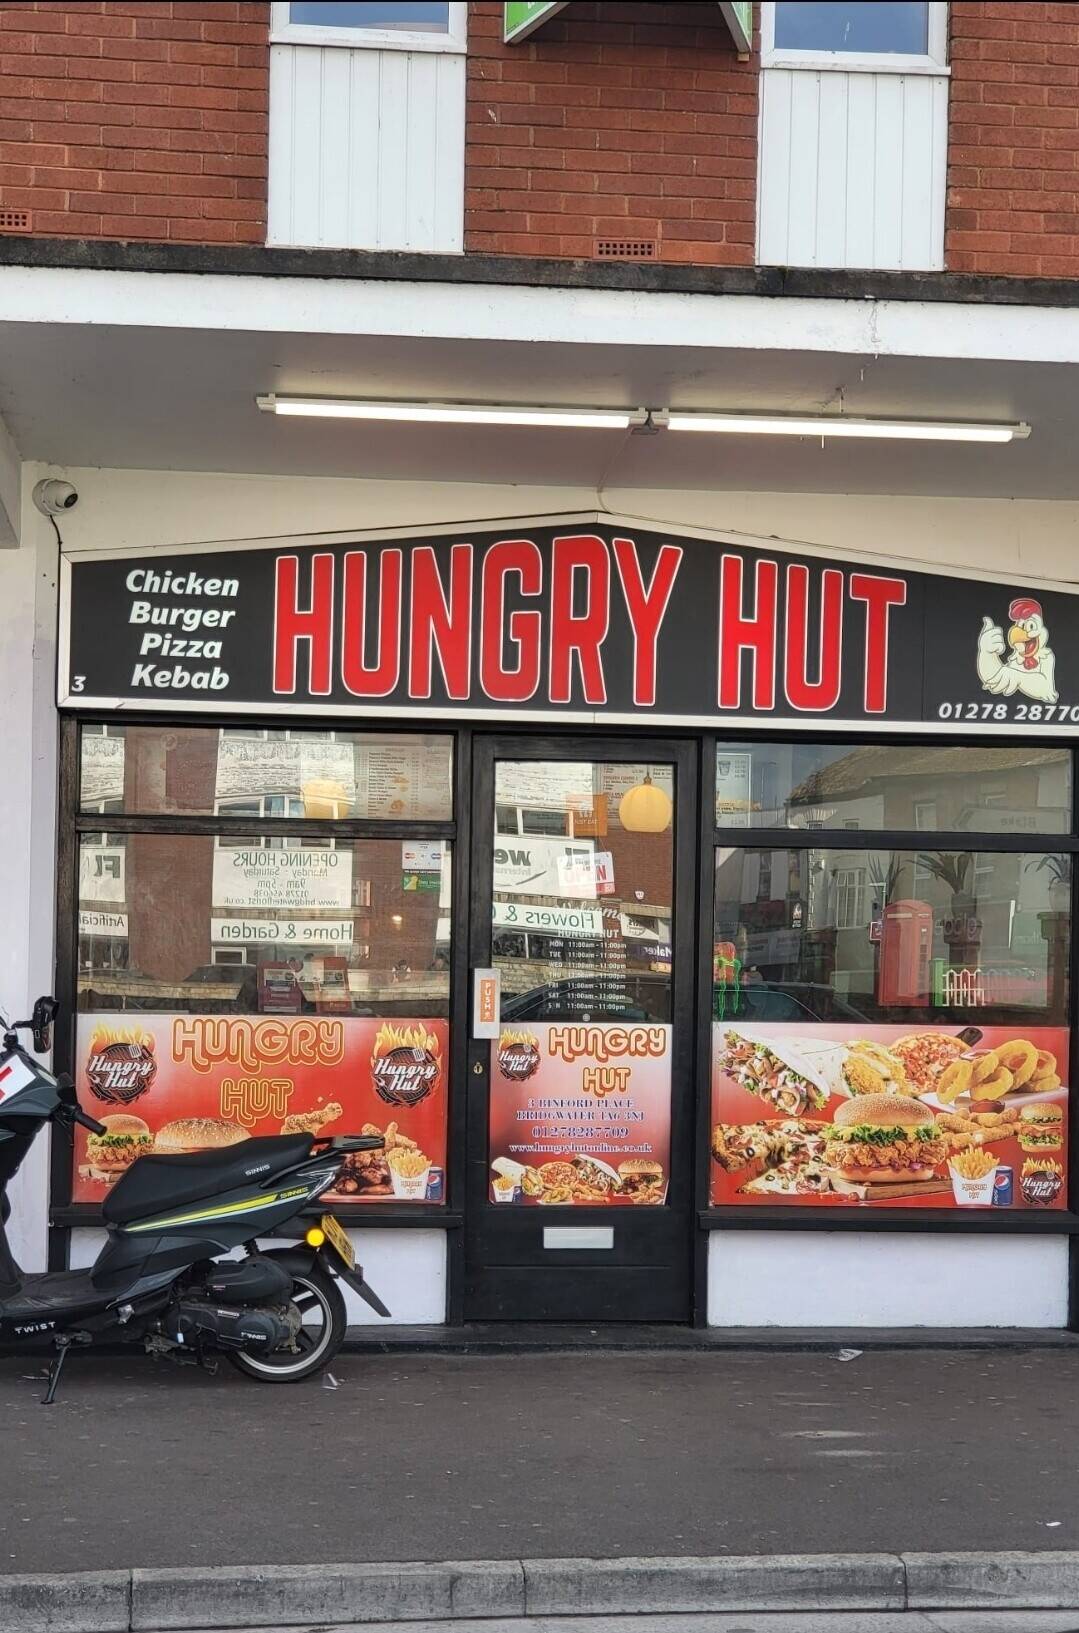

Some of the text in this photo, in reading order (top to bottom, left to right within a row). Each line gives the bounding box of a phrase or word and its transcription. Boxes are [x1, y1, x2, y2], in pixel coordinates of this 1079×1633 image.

[126, 569, 240, 598] Chicken
[129, 601, 235, 631] Burger
[272, 534, 907, 714] HUNGRY HUT
[139, 633, 222, 660] Pizza
[72, 676, 87, 693] 3
[131, 664, 230, 691] Kebab
[938, 702, 1008, 720] 01278
[553, 902, 624, 920] Wlcome
[172, 1018, 344, 1075] HUNGRY
[548, 1027, 666, 1063] HUNGRY
[89, 1055, 153, 1076] Hungry
[500, 1050, 538, 1064] Hungry
[509, 1061, 530, 1071] Hut
[374, 1058, 437, 1080] Hungry
[104, 1071, 137, 1088] Hut
[390, 1074, 421, 1091] Hut
[583, 1067, 631, 1097] HUT
[220, 1078, 294, 1128] HUT
[540, 1099, 593, 1108] BINFORD
[597, 1100, 634, 1108] PLACE
[516, 1110, 595, 1120] BRIDGWATER
[532, 1126, 629, 1139] 01278287709
[1022, 1177, 1061, 1190] Hungry
[1032, 1187, 1052, 1196] Hut
[14, 1321, 56, 1335] TWIST
